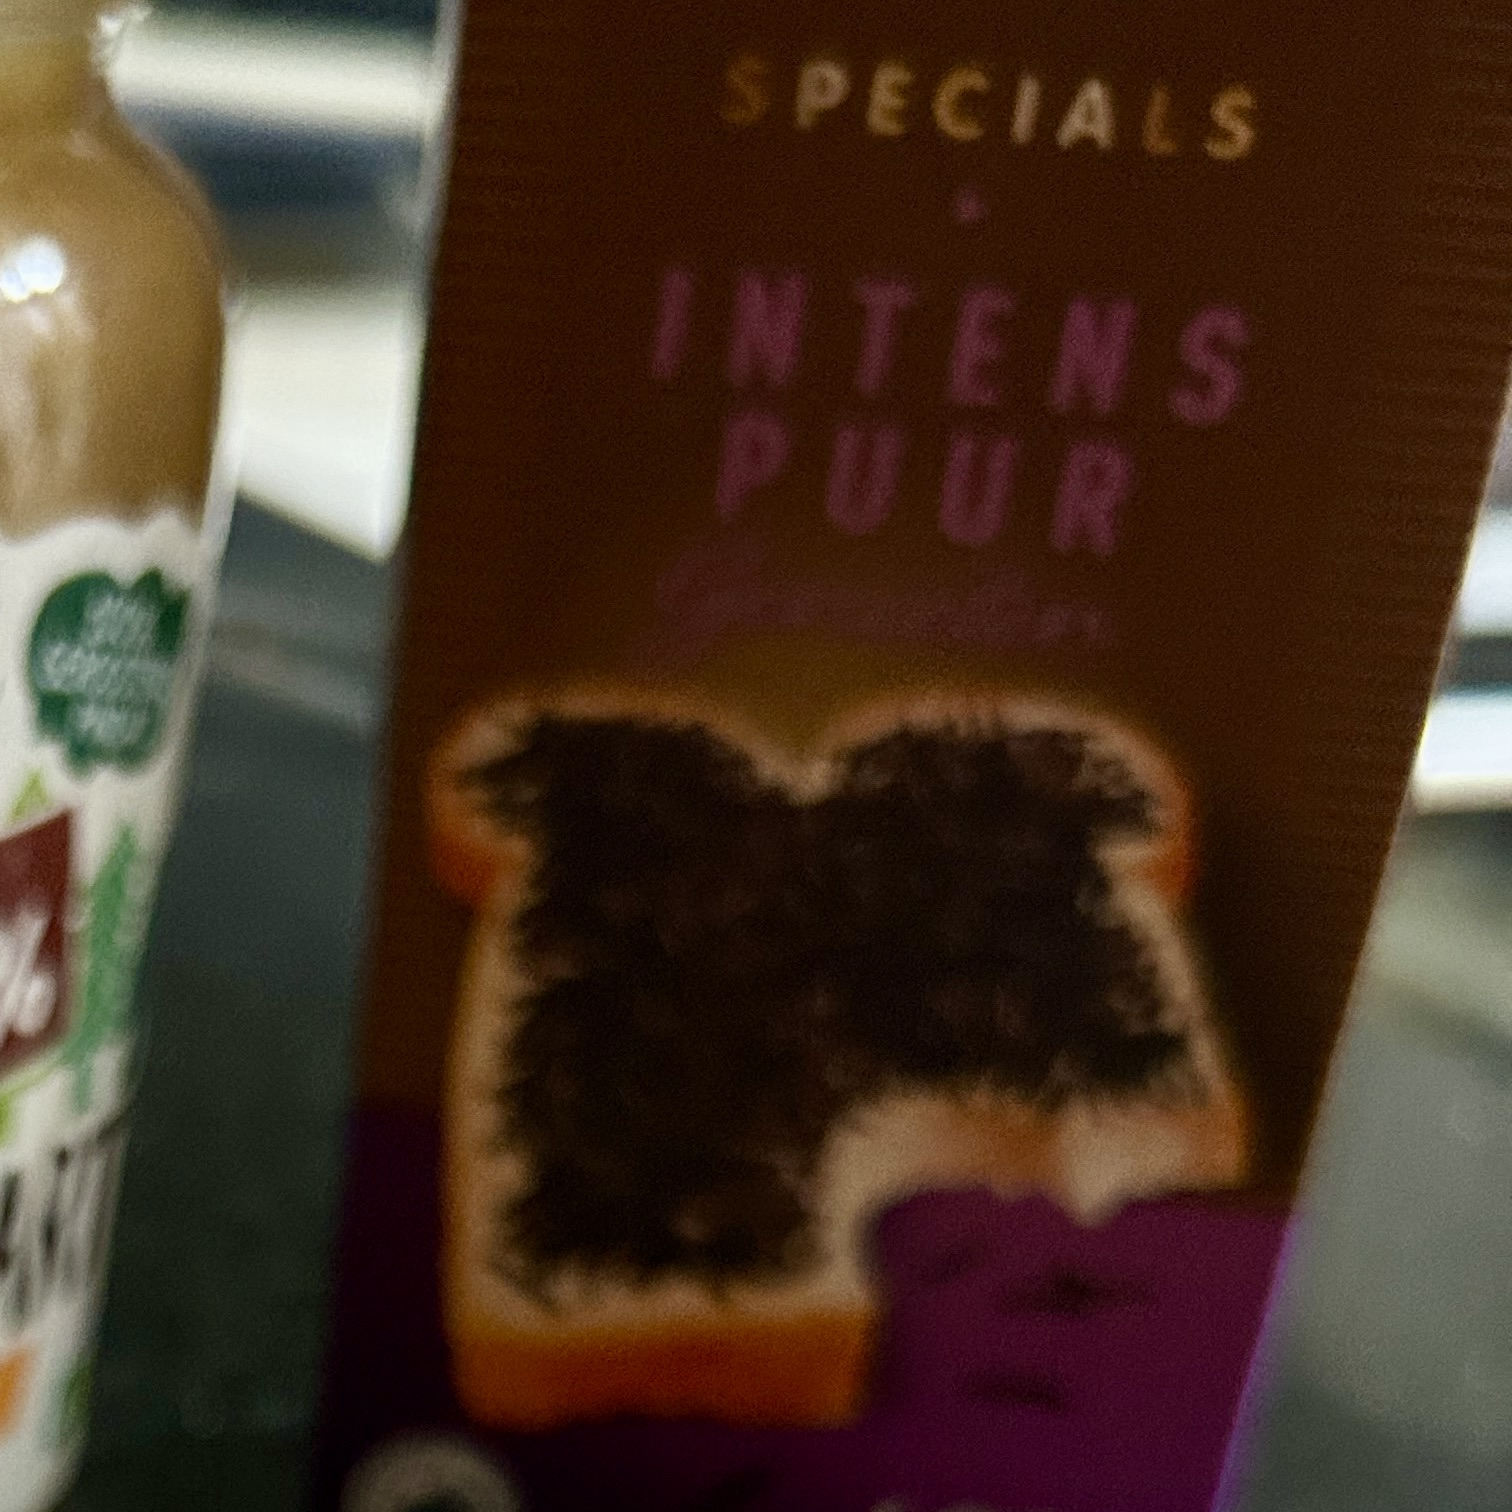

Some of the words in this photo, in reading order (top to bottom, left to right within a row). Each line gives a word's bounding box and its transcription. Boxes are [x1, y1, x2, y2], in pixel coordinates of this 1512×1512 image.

[720, 51, 1259, 162] SPECIALS
[651, 266, 1253, 426] INTENS
[715, 410, 1136, 557] PUUR
